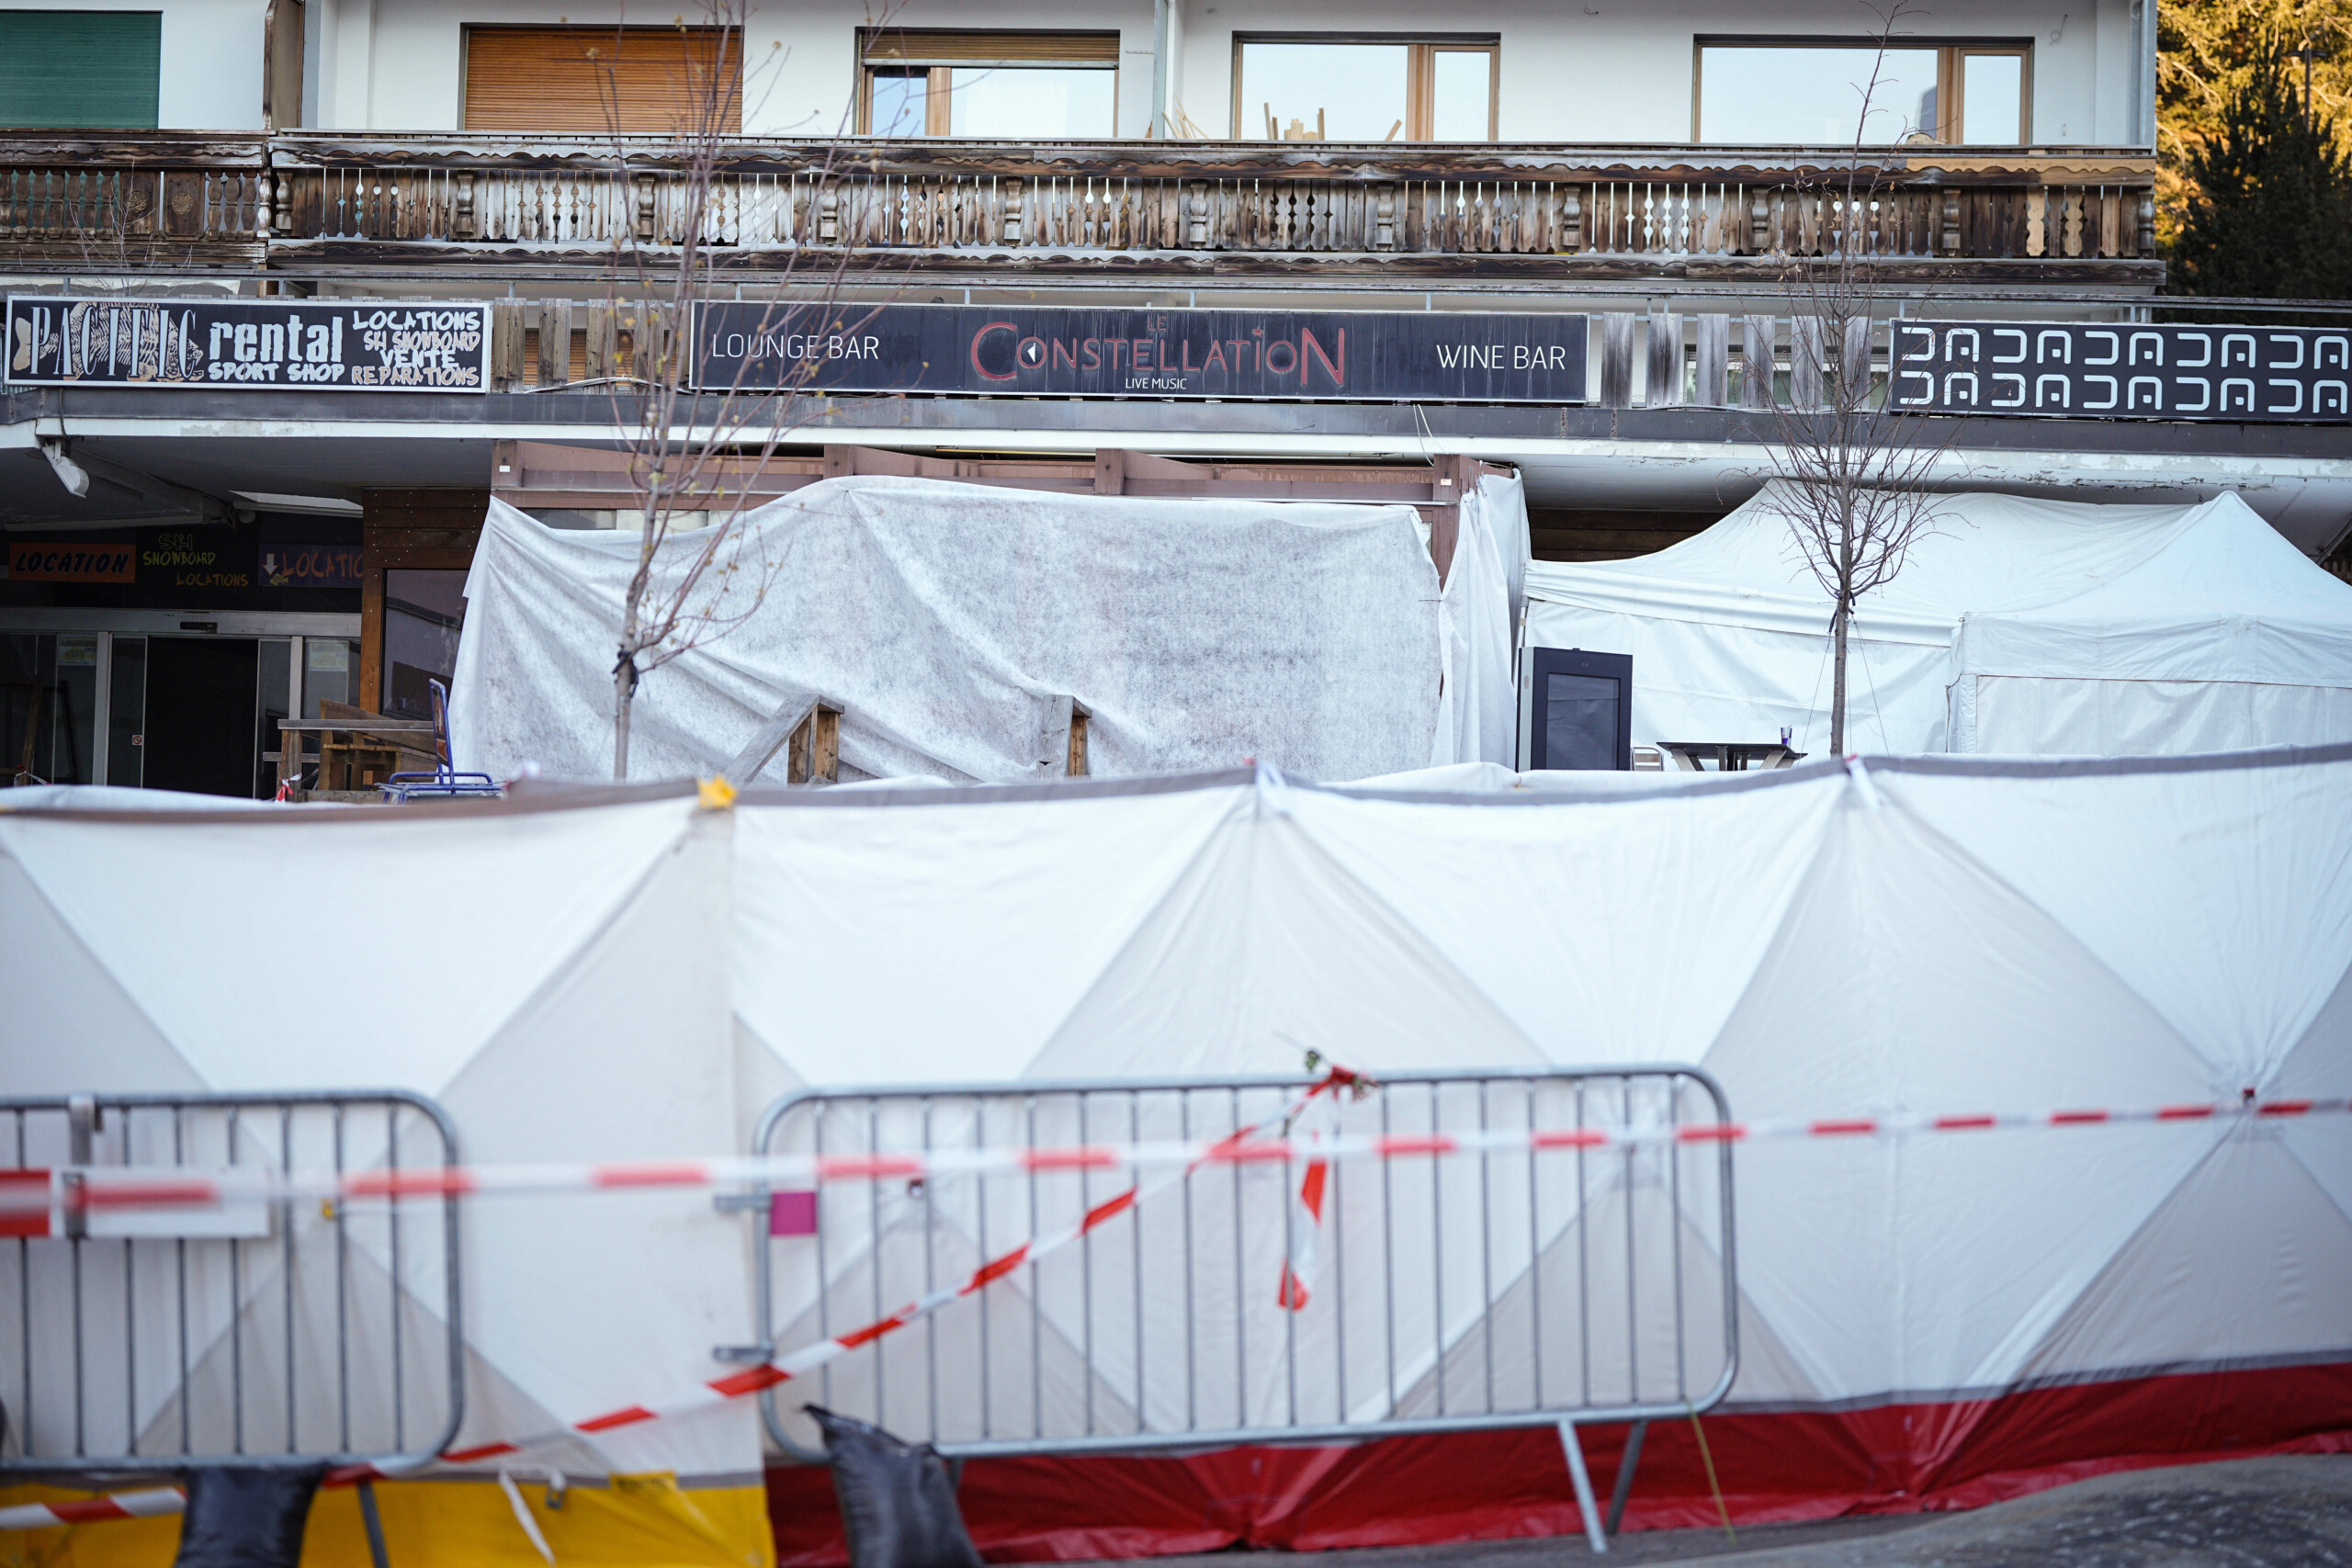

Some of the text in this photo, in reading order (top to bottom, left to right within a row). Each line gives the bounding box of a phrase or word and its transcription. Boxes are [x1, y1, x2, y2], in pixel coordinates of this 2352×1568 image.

[352, 310, 481, 331] LOCATIONS
[1147, 315, 1167, 332] LE
[28, 306, 197, 378] PACIFIC
[209, 314, 344, 363] rental
[363, 331, 481, 352] SKI SNOWBOARD
[712, 333, 879, 360] LOUNGE BAR
[379, 349, 459, 367] VENTE
[1437, 344, 1566, 370] WINE BAR
[208, 362, 345, 382] SPORT SHOP
[1125, 378, 1187, 390] LIVE MUSIC
[158, 533, 194, 551] SKI
[15, 551, 130, 574] LOCATION
[142, 551, 216, 566] SNOWBOARD
[176, 572, 249, 588] LOCATIONS
